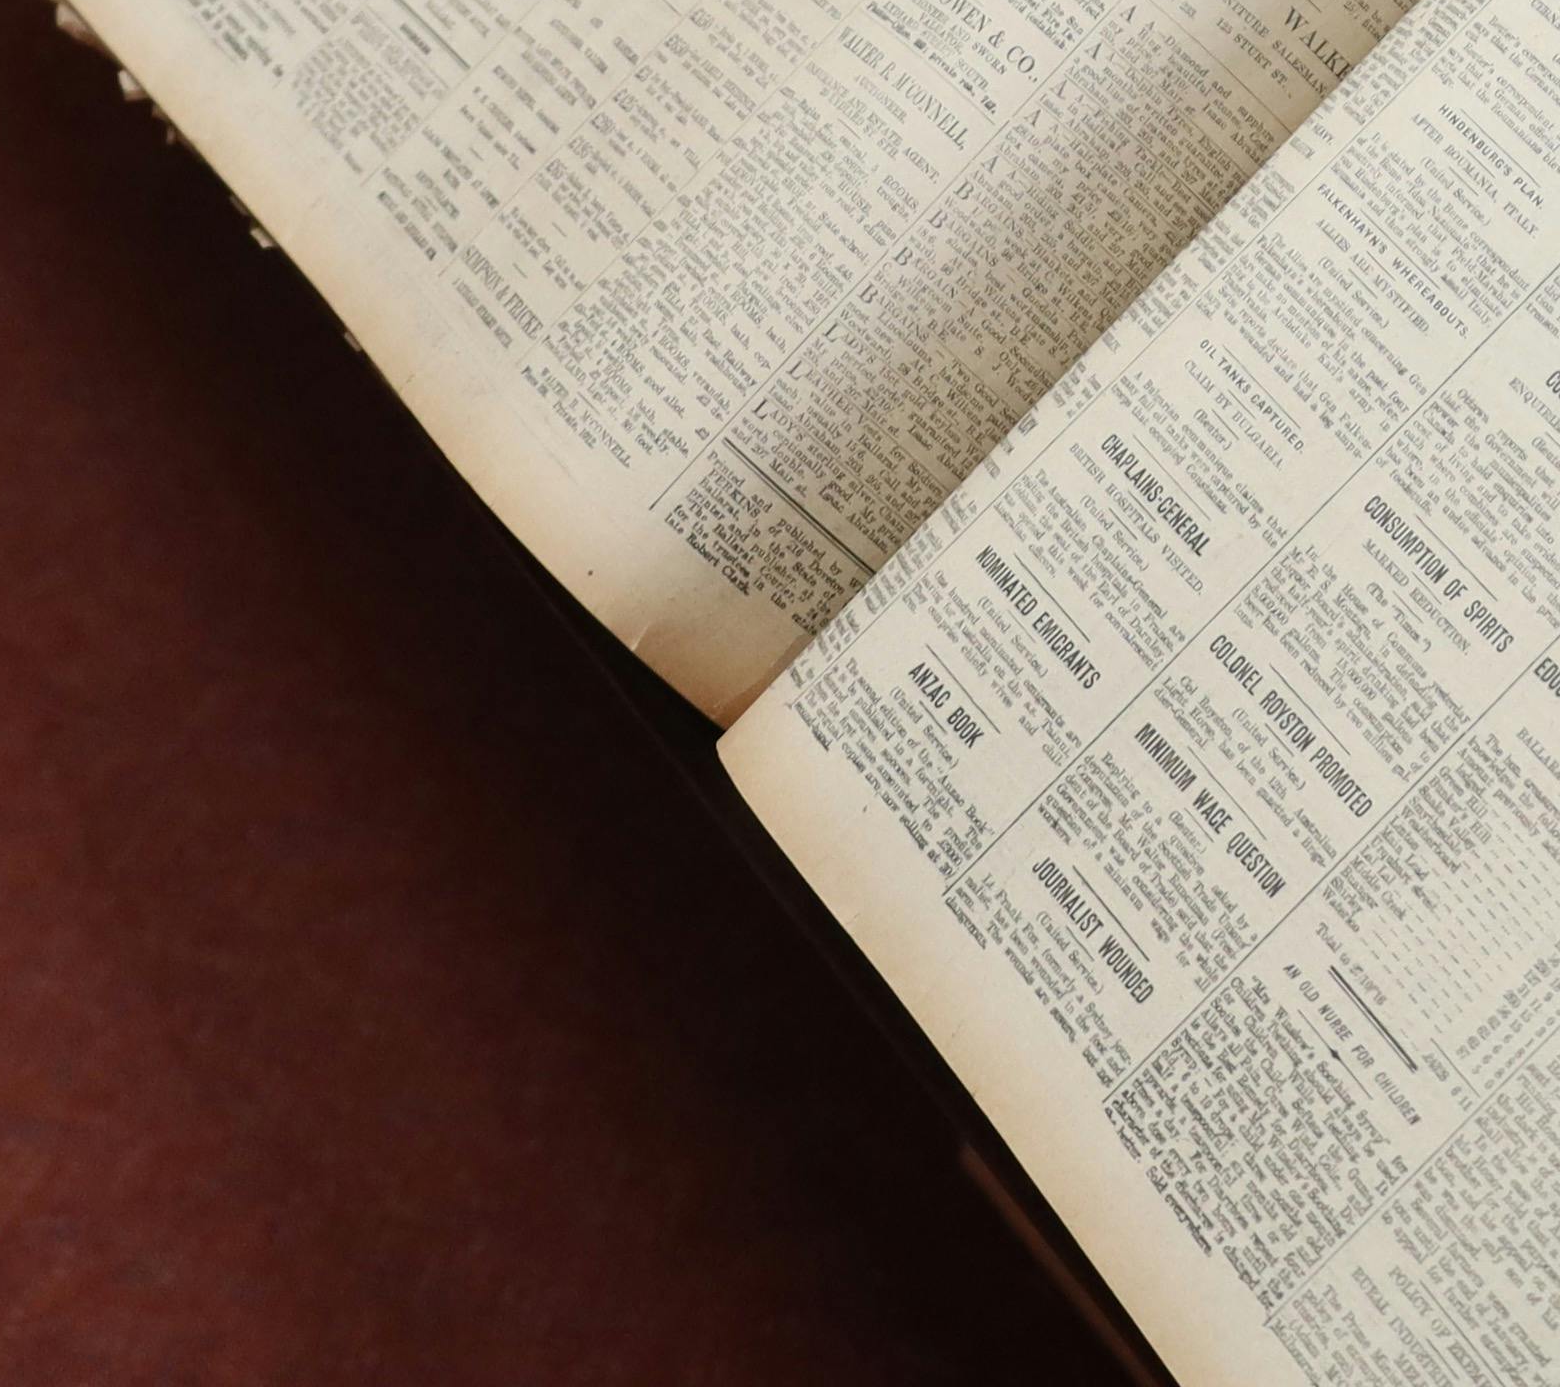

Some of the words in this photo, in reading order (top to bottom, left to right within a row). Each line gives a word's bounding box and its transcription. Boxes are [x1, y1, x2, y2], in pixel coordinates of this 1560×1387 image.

[1198, 337, 1218, 361] OIL
[1216, 355, 1253, 395] TANKS
[1249, 392, 1305, 455] CAPTURED.
[1099, 432, 1212, 558] CHAPLAINS-GENERAL
[907, 661, 953, 710] ANZAC
[945, 704, 986, 750] BOOK
